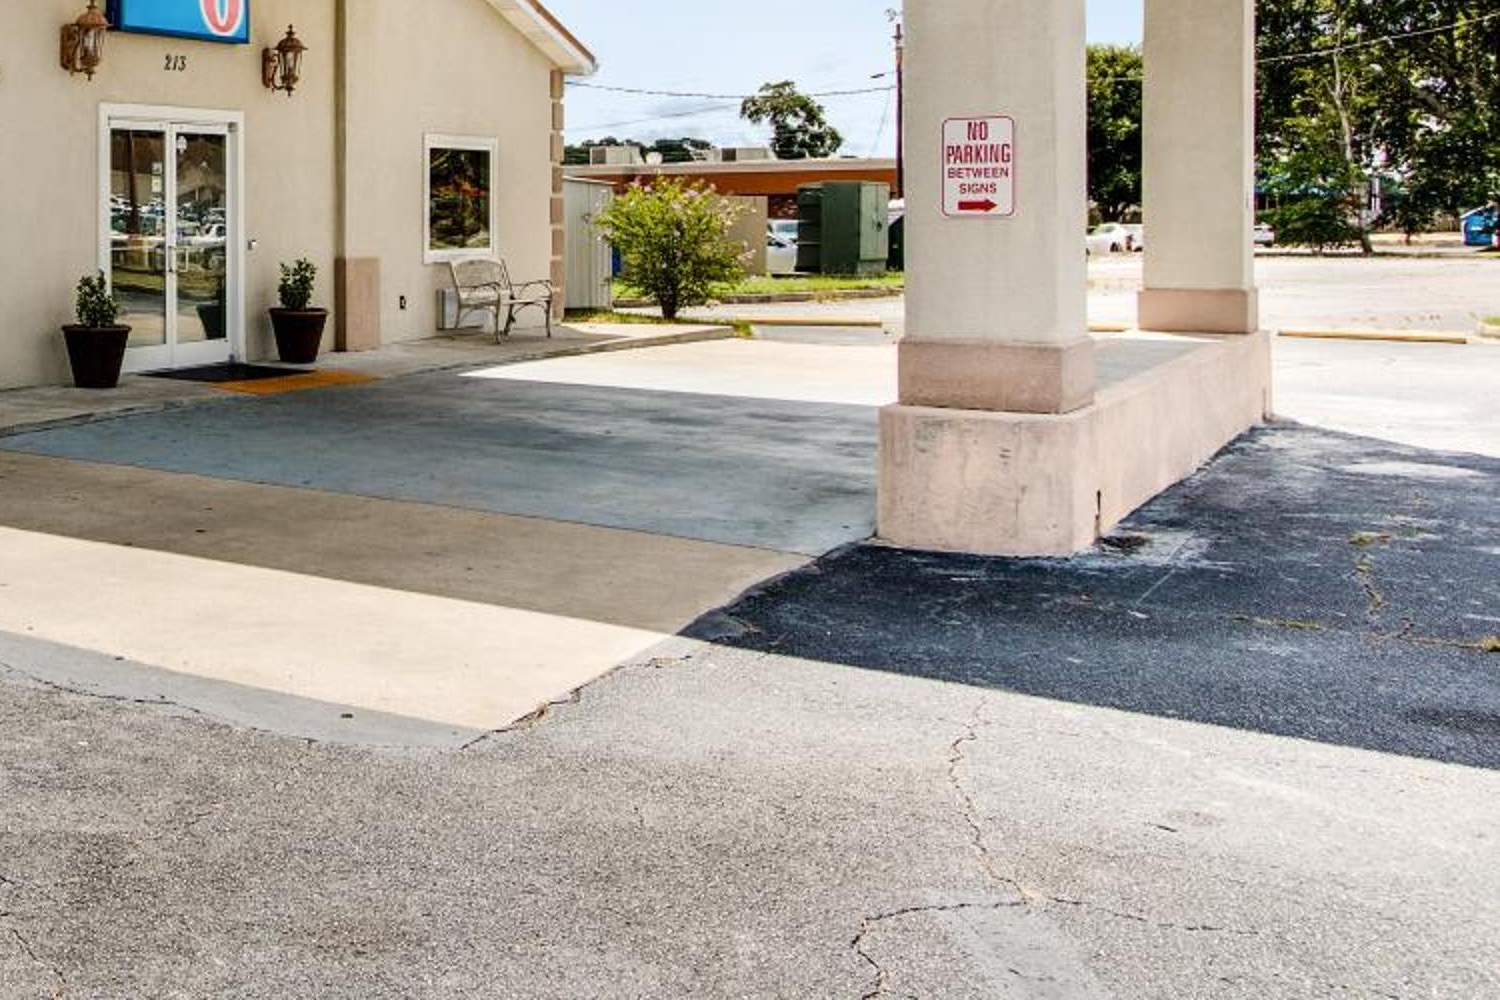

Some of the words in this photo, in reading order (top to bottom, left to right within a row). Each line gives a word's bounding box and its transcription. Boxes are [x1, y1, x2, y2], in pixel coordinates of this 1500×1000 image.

[163, 54, 187, 72] 213
[967, 121, 989, 141] NO
[946, 143, 1011, 164] PARKING
[947, 167, 1009, 179] BETWEEN
[958, 182, 997, 195] SIGNS
